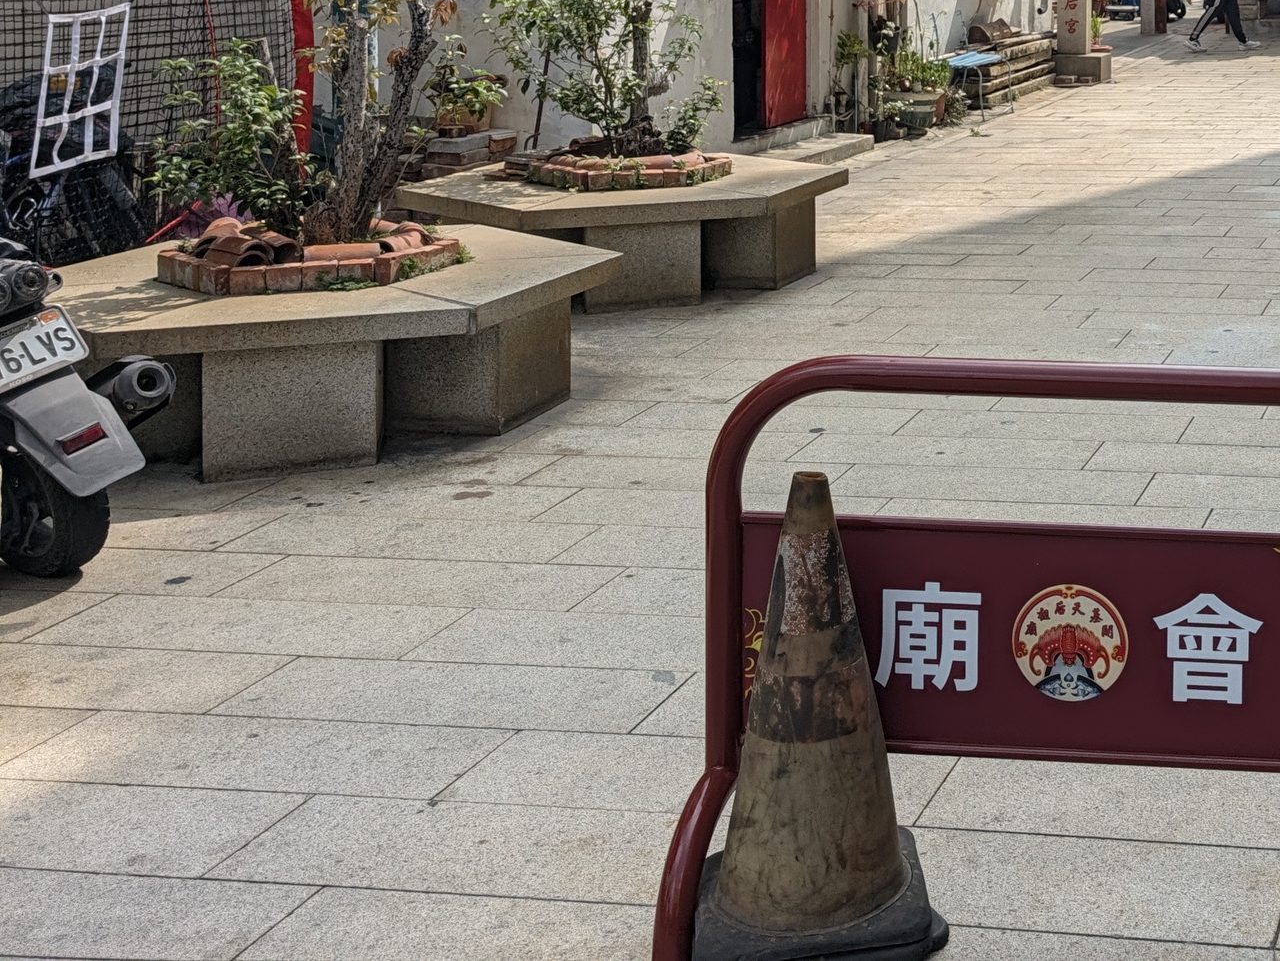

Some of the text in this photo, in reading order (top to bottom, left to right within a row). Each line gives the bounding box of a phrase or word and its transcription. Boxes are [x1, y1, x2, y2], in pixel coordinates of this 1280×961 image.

[0, 326, 76, 380] 6-LVS
[9, 374, 33, 387] KOSO
[874, 581, 1264, 705] 廟 會
